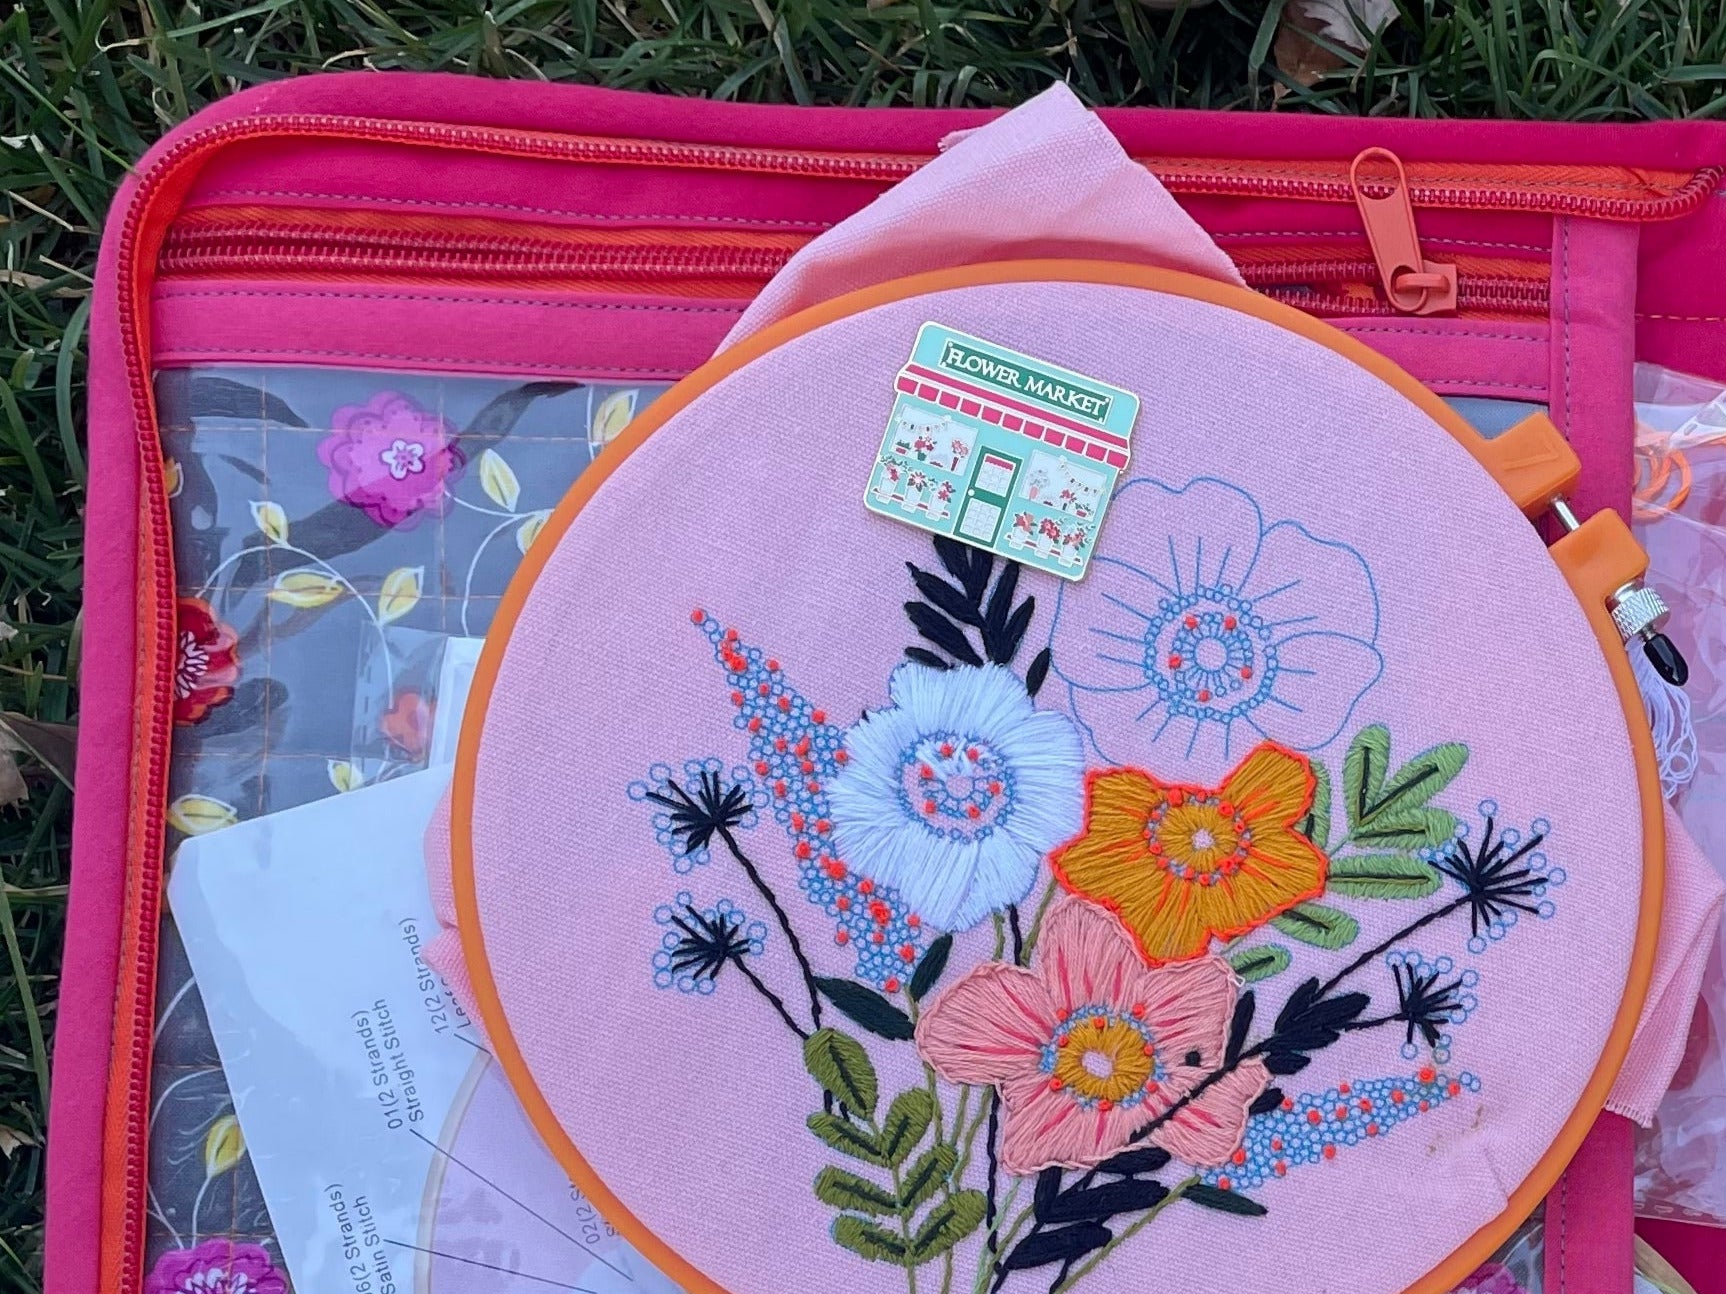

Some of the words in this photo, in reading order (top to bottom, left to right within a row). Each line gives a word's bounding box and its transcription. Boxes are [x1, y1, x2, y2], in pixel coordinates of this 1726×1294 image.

[947, 346, 1022, 388] FLOWER
[1026, 375, 1106, 417] MARKET
[351, 1011, 388, 1086] Strands)
[372, 999, 399, 1050] Stitch
[390, 1052, 424, 1122] Straight
[324, 1184, 360, 1260] Strands)
[353, 1195, 380, 1247] Stitch
